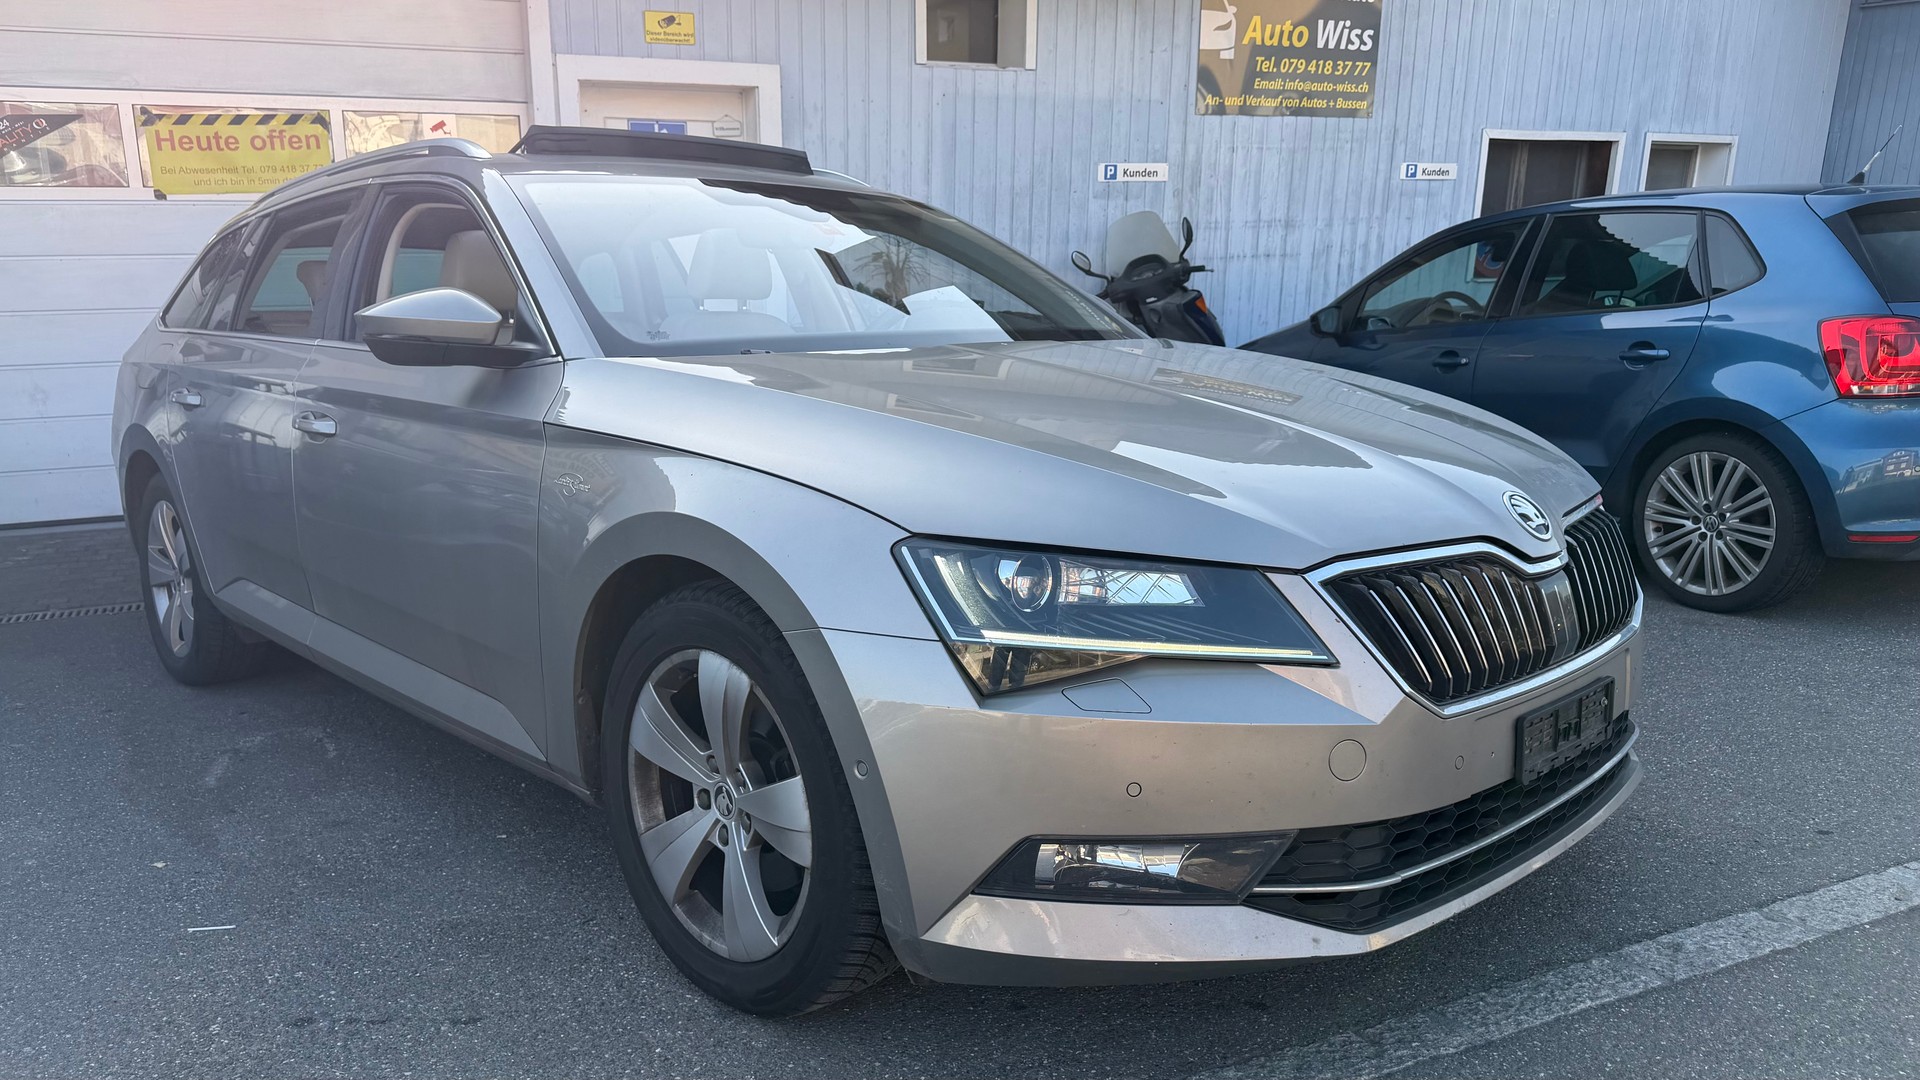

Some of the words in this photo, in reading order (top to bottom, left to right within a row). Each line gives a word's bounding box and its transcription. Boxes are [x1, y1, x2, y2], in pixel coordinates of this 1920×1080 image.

[1241, 15, 1309, 48] Auto
[1316, 19, 1374, 51] Wiss
[1255, 56, 1277, 73] Tel.
[1280, 58, 1306, 74] 079
[1307, 59, 1333, 75] 418
[1334, 60, 1353, 75] 37
[1353, 61, 1372, 76] 77
[1254, 78, 1284, 90] Email:
[1284, 79, 1369, 92] info@auto-wiss.ch
[1204, 93, 1224, 106] An-
[1224, 94, 1245, 106] und
[1245, 94, 1282, 107] Verkauf
[1282, 98, 1299, 107] von
[1300, 97, 1327, 108] Autos
[1328, 100, 1335, 108] +
[1335, 97, 1368, 109] Bussen
[154, 129, 240, 152] Heute
[249, 129, 322, 151] offen
[160, 166, 177, 175] Bei
[178, 165, 239, 175] Abwesenheit
[241, 165, 258, 174] Tel.
[259, 165, 278, 174] 079
[280, 165, 297, 173] 418
[299, 164, 310, 173] 37
[1122, 167, 1159, 178] Kunden
[1421, 167, 1450, 177] Kunden
[193, 178, 212, 186] und
[214, 177, 228, 186] ich
[230, 177, 245, 185] bin
[247, 176, 256, 185] in
[258, 176, 280, 185] 5min
